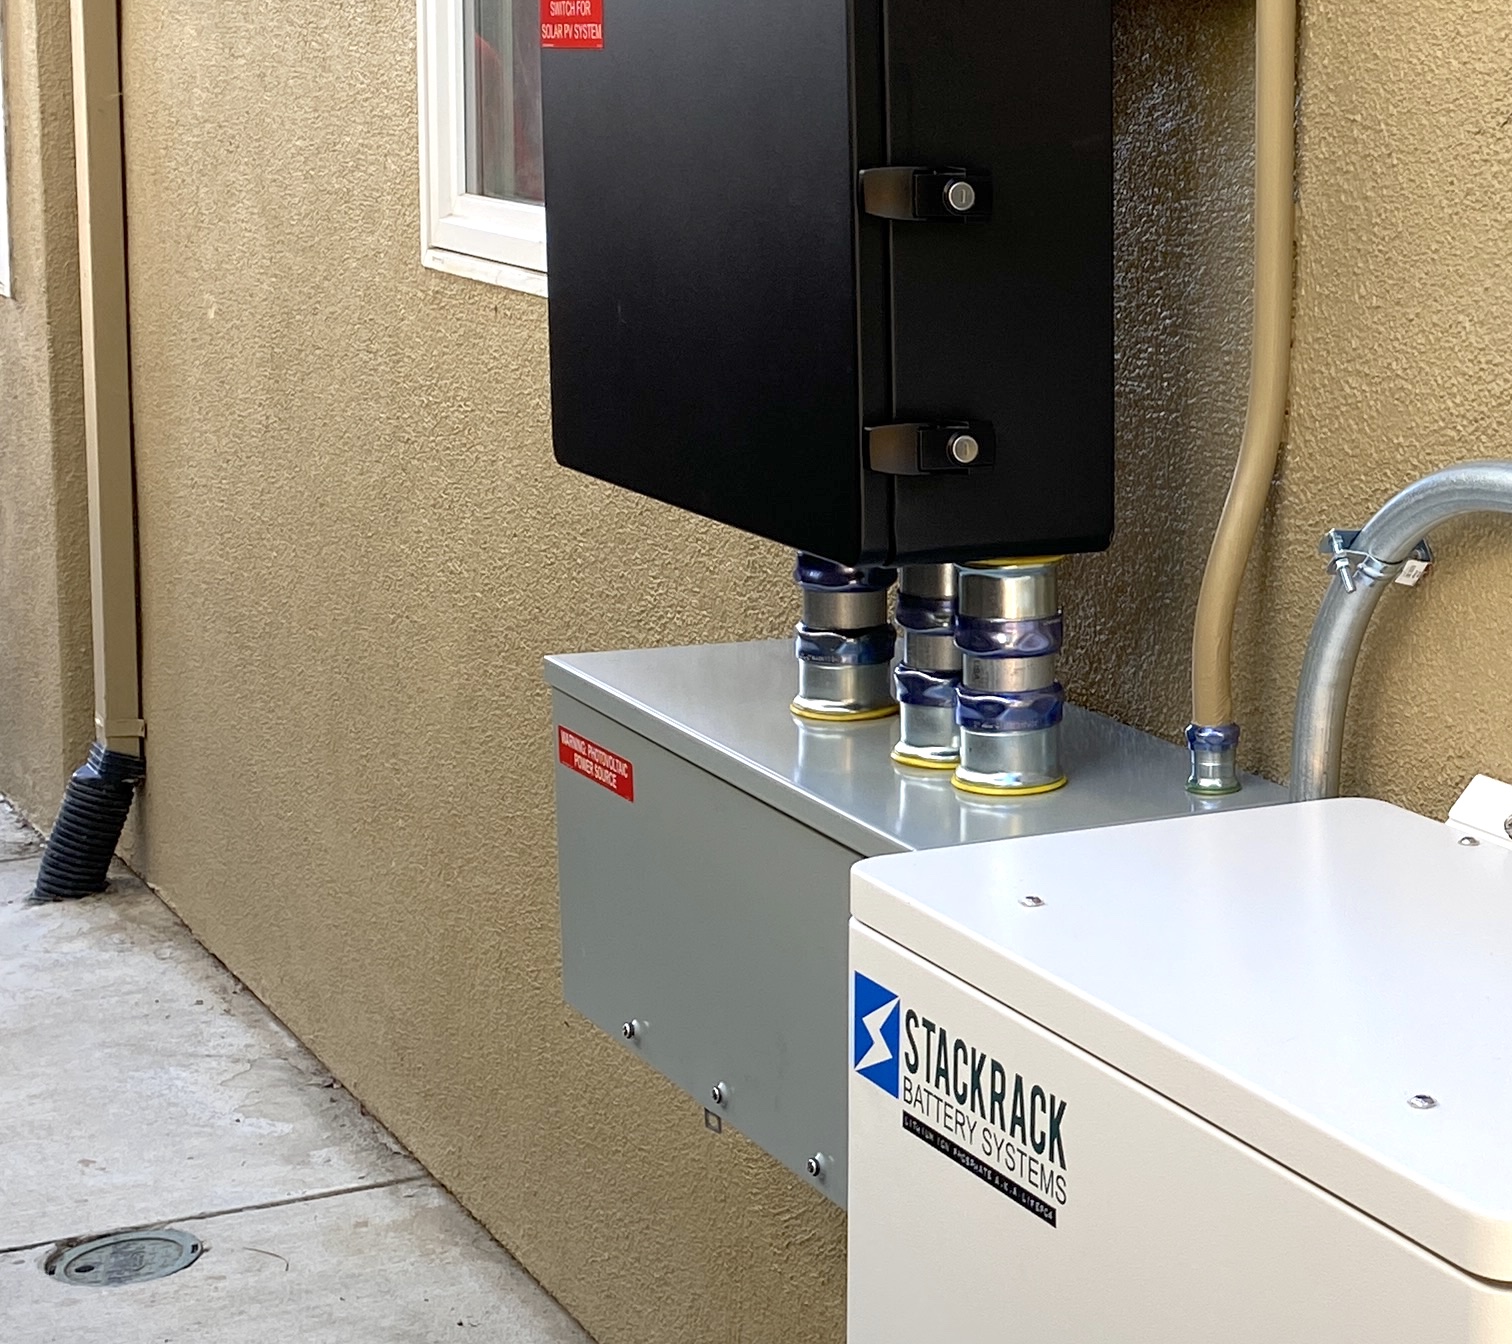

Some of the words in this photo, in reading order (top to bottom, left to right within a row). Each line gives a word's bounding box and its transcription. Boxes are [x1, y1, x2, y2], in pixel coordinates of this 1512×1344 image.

[550, 0, 575, 16] SWITCH
[576, 0, 591, 16] FOR
[542, 24, 563, 39] SOLAR
[564, 24, 573, 39] PV
[574, 24, 602, 39] SYSTEM
[904, 1009, 1067, 1171] STACKRACK
[902, 1076, 977, 1145] BATTERY
[982, 1127, 1067, 1206] SYSTEMS
[953, 1146, 992, 1181] PHOSPHATE
